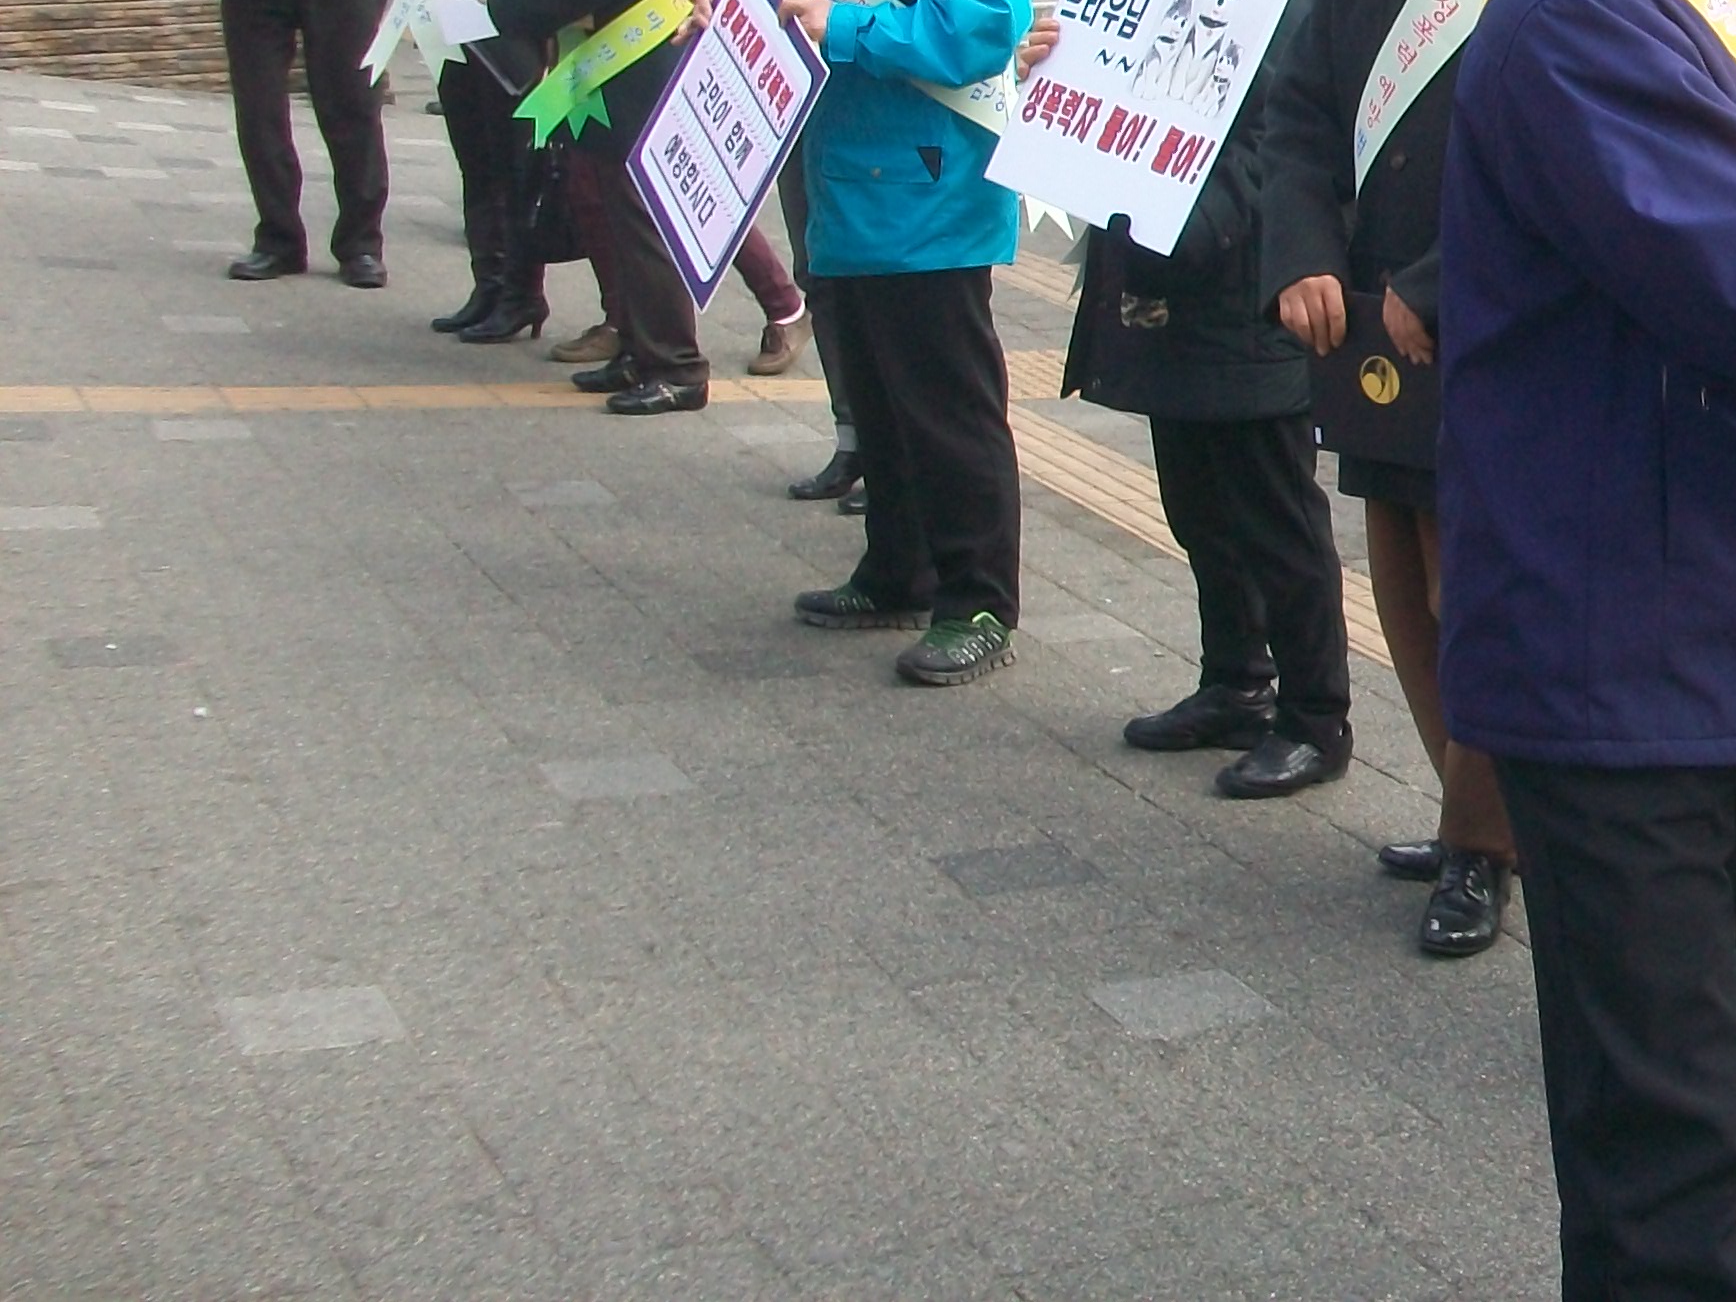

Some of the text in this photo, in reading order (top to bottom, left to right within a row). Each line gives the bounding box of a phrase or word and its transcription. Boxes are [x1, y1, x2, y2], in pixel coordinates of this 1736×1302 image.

[698, 68, 754, 171] 구민이 함께
[1021, 77, 1103, 144] 성폭력자
[664, 133, 717, 229] 예방합시다
